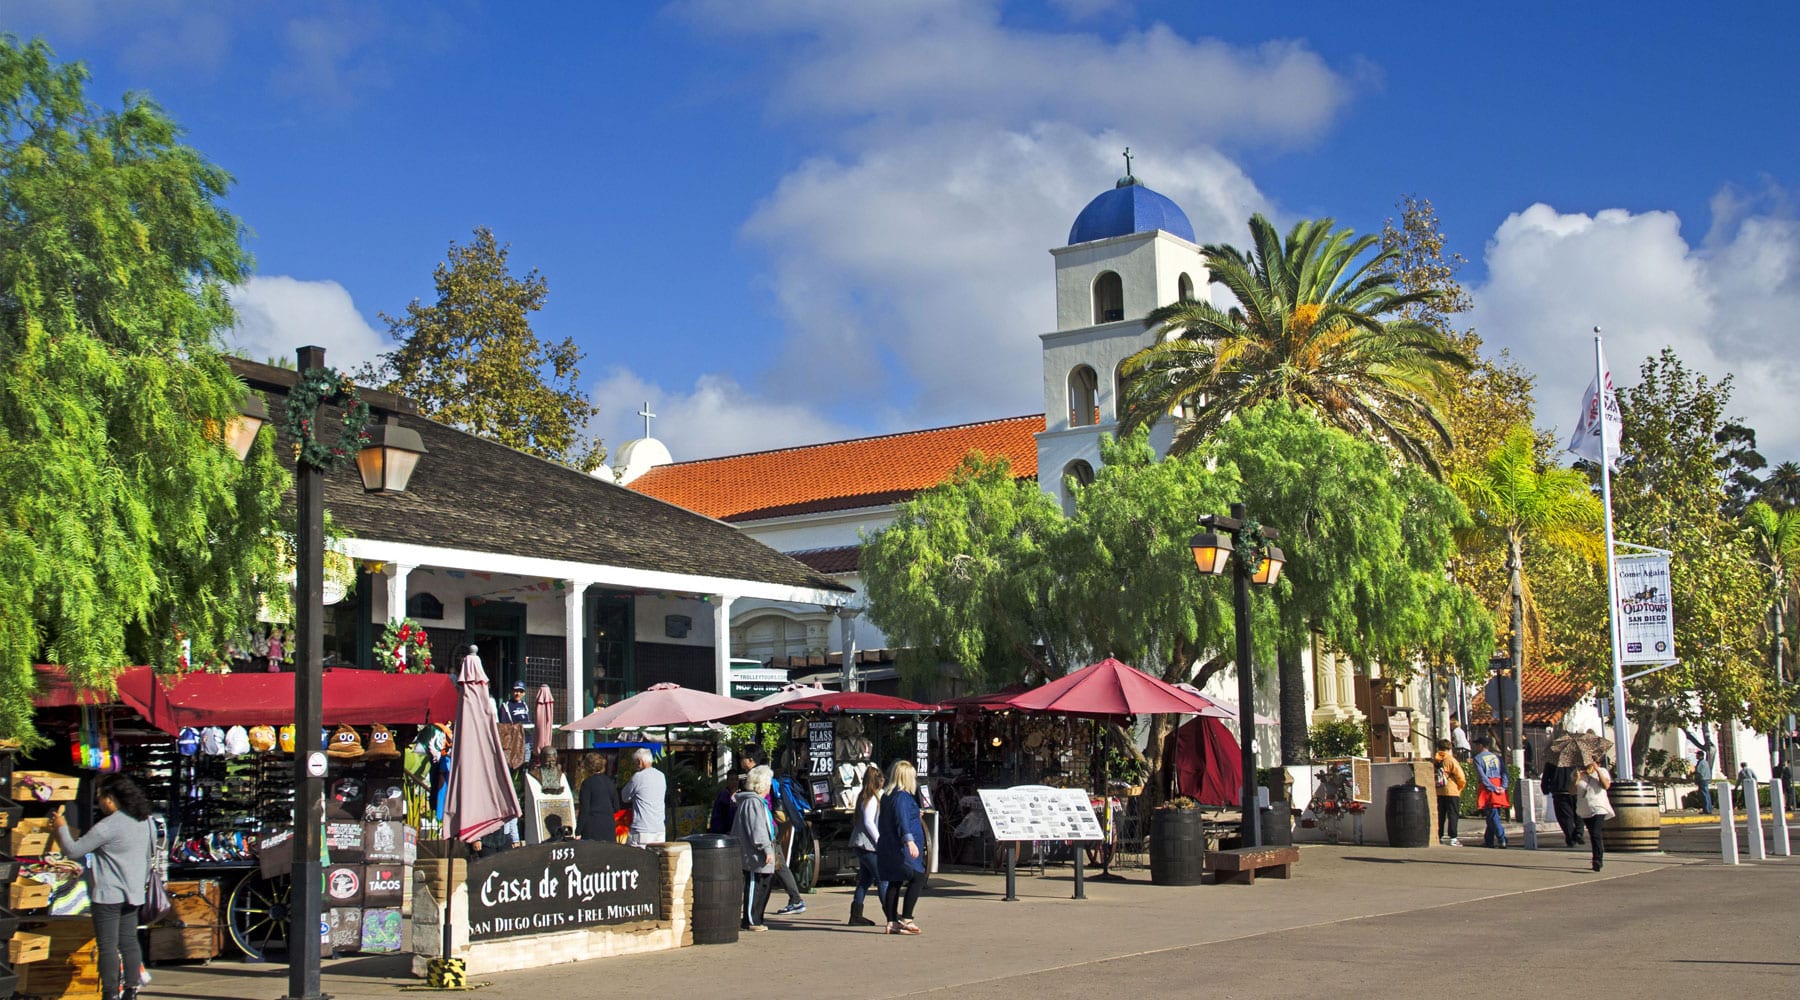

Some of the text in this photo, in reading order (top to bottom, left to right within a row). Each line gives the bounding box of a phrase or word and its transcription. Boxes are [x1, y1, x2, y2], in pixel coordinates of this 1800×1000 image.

[1644, 614, 1667, 622] DIEGO
[810, 730, 833, 742] GLASS
[810, 757, 834, 773] 7.99
[551, 848, 575, 861] 1853
[376, 871, 380, 880] I
[369, 880, 401, 891] TACOS
[481, 863, 639, 907] Casa de Aguirre
[495, 915, 530, 932] DIEGO
[533, 912, 565, 928] GIFTS
[578, 907, 603, 923] FREE
[607, 903, 653, 920] MUSEUM
